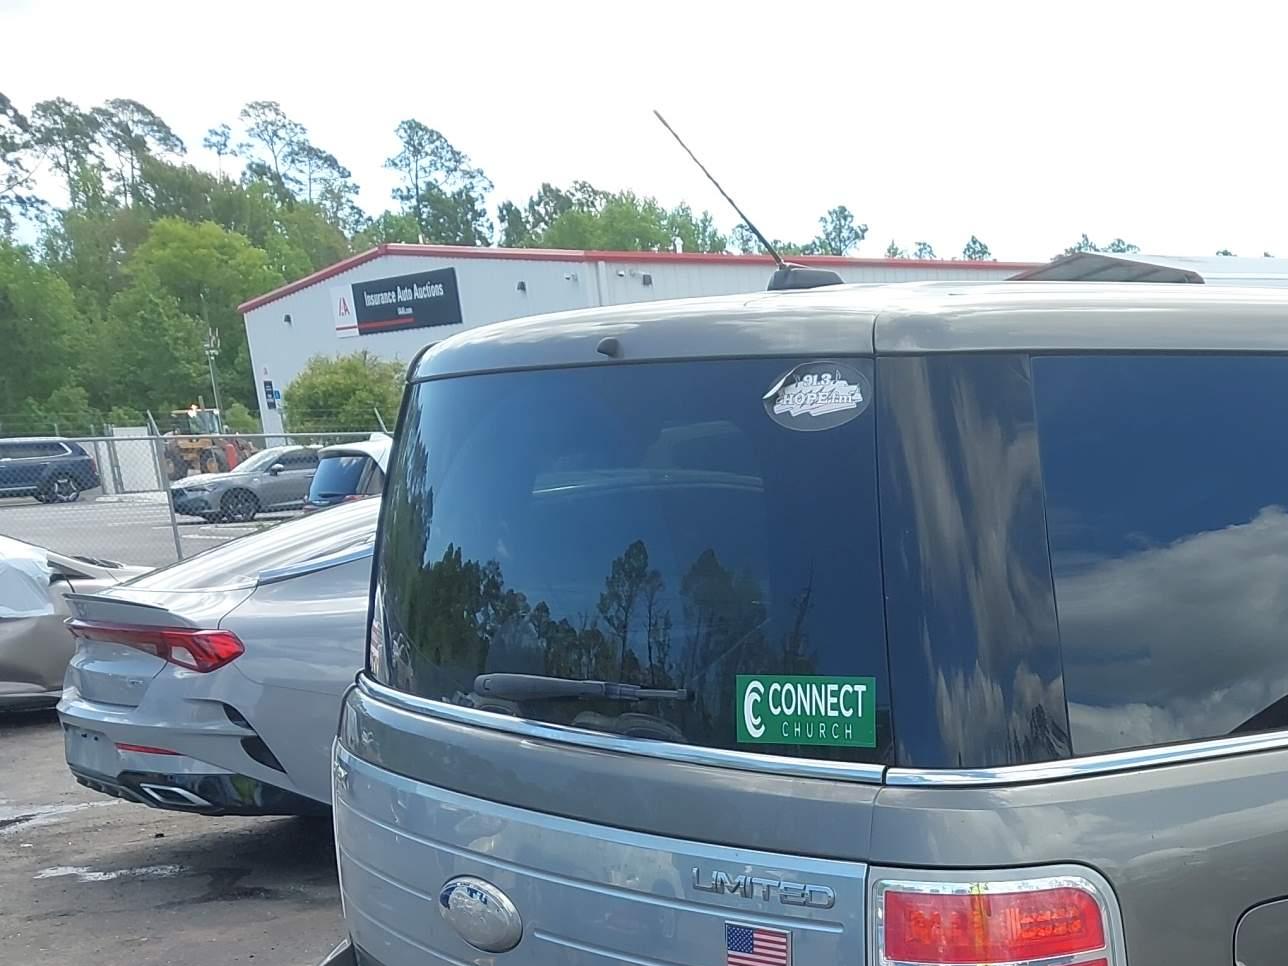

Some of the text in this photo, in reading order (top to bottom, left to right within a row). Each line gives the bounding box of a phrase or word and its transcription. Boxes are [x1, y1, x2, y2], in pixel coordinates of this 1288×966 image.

[364, 281, 444, 306] Insurance Auto Auctions
[802, 373, 832, 387] 91.3
[768, 682, 867, 718] CONNECT
[781, 721, 853, 740] CHURCH
[691, 867, 836, 909] LIMITED
